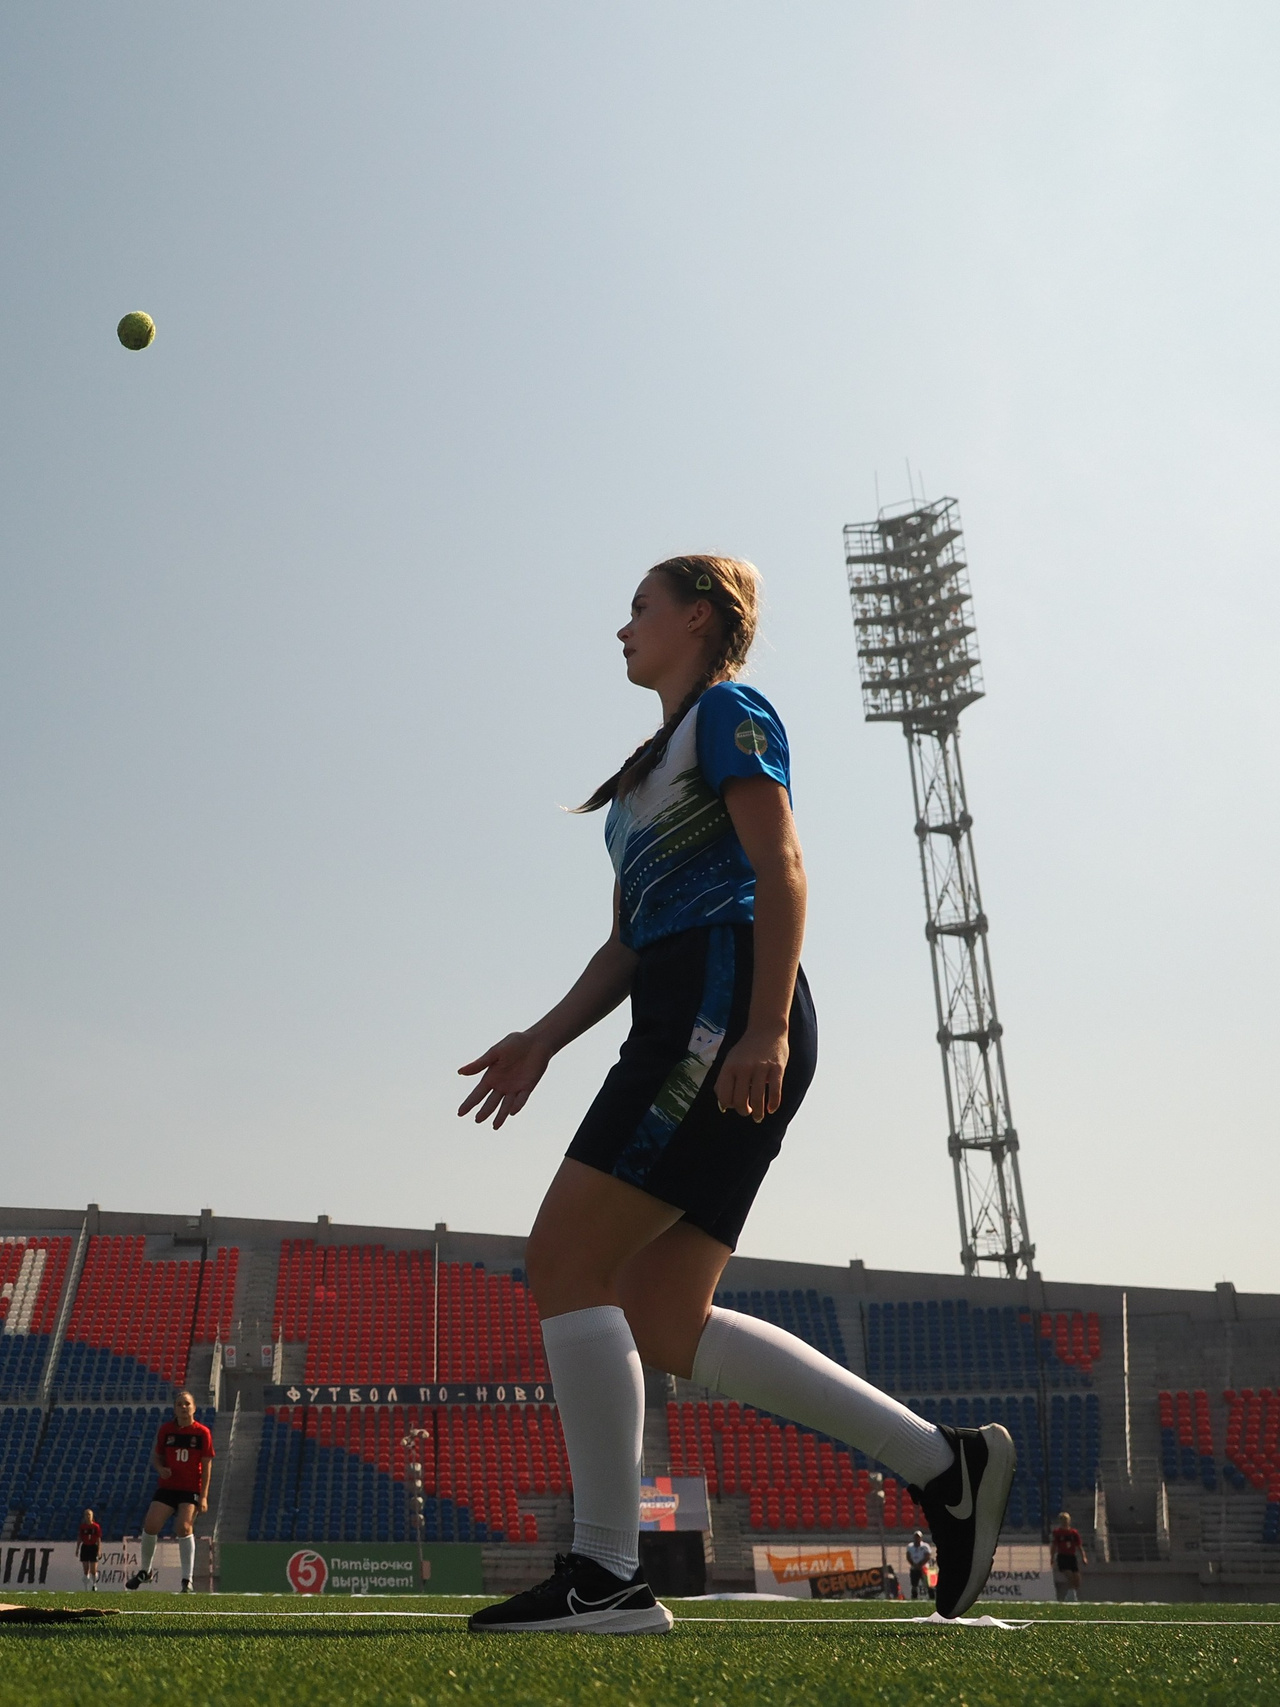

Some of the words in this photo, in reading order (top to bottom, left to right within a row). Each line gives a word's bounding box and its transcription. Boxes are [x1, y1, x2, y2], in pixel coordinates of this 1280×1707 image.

[286, 1386, 398, 1402] ФУТБОЛ
[420, 1386, 545, 1402] ПО-НОВО
[175, 1448, 189, 1462] 10
[331, 1558, 413, 1572] Пятёрочка
[332, 1576, 414, 1594] выручает!
[817, 1569, 883, 1595] СЕРВИС
